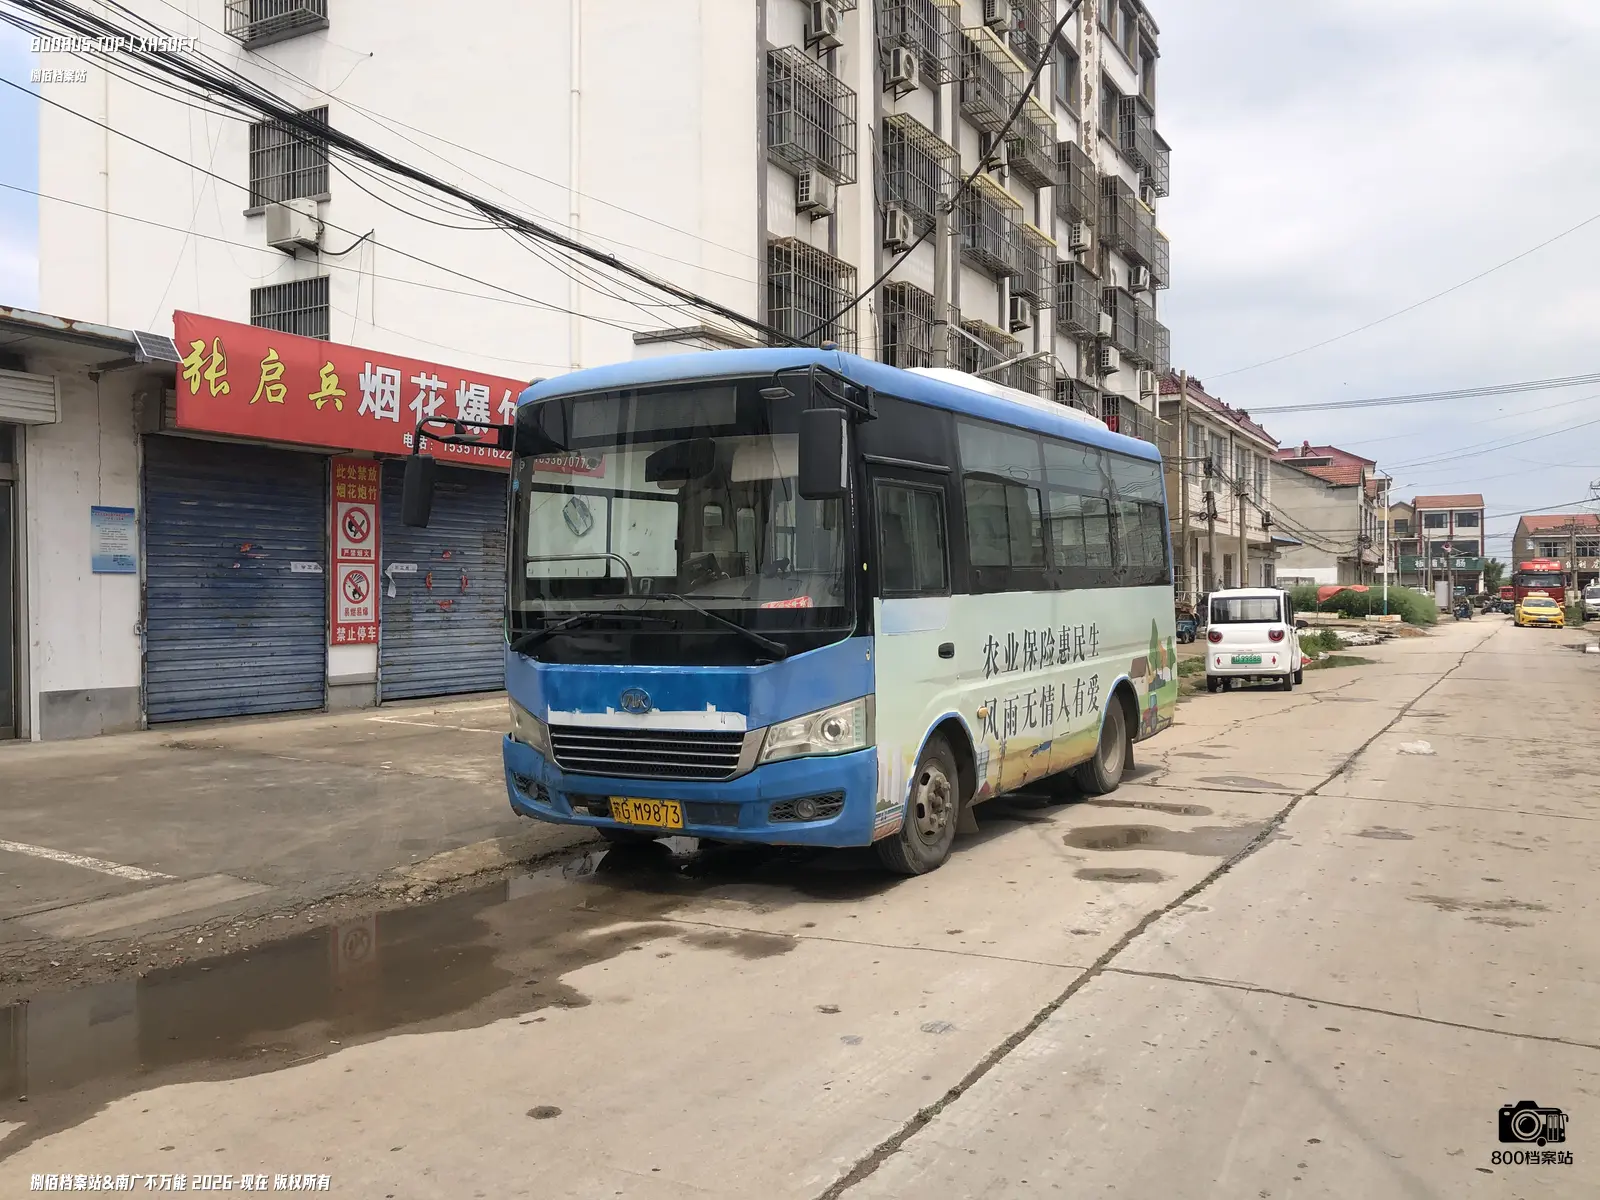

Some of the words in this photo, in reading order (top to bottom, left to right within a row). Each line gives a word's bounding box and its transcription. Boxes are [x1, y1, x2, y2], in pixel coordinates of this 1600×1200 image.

[182, 336, 347, 411] 张启兵
[443, 442, 513, 460] 1535181622
[336, 464, 377, 481] 此处禁放
[336, 482, 377, 500] 烟花炮竹
[336, 626, 377, 642] 禁止停车
[982, 622, 1100, 680] 农业保险惠民生
[980, 673, 1100, 743] 风雨无情人有爱
